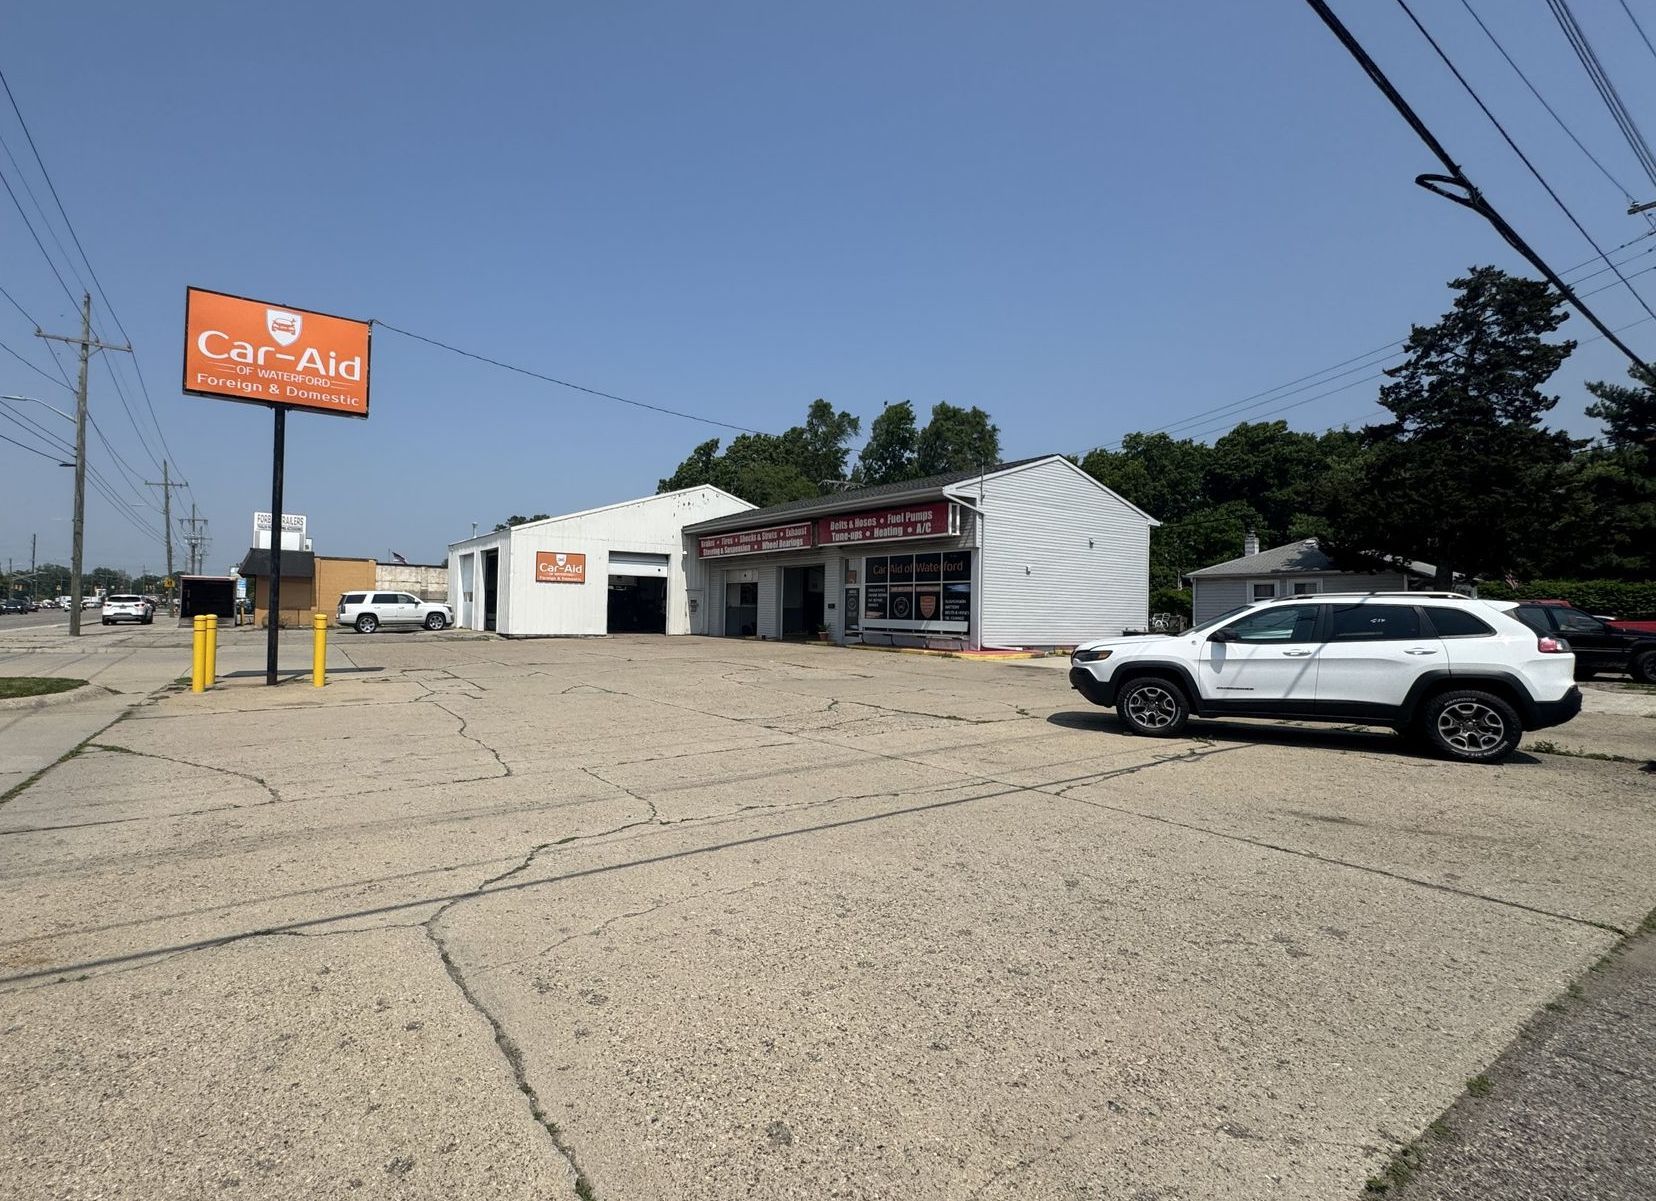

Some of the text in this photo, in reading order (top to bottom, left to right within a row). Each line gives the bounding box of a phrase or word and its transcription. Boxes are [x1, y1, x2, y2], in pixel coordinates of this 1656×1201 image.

[197, 330, 361, 381] Car-Aid
[236, 365, 331, 388] OF WATERFORD
[197, 373, 360, 406] Foreign & Domestic
[830, 521, 848, 531] Belts
[854, 518, 877, 528] Hoses
[887, 513, 904, 524] Fuel
[906, 510, 933, 522] Pumps
[831, 522, 932, 542] Tune-ups Heating A/C
[539, 563, 583, 574] Car-Aid
[873, 565, 887, 575] Car
